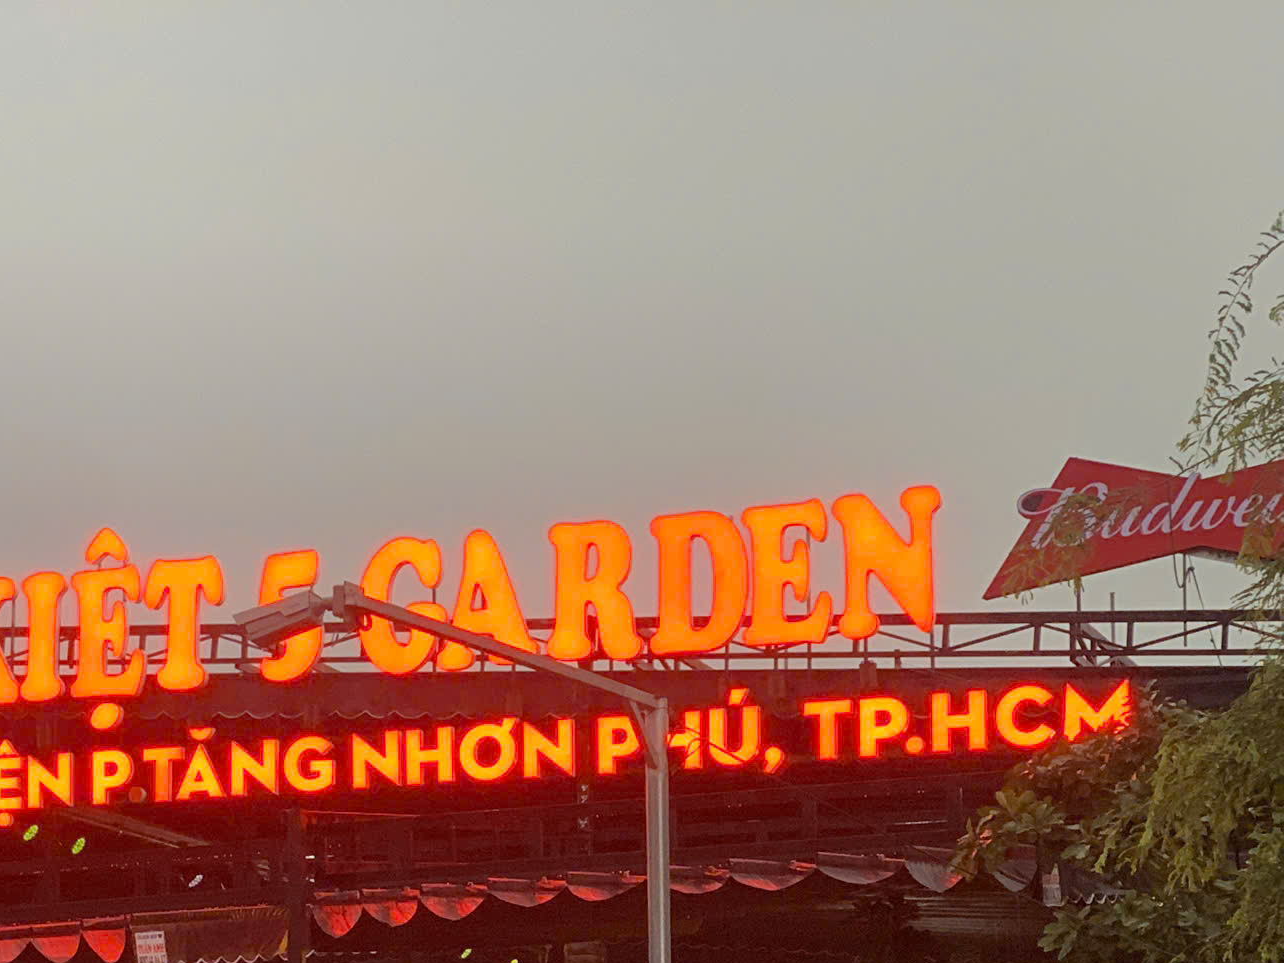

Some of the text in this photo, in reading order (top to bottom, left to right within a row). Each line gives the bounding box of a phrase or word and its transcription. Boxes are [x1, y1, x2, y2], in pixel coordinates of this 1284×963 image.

[1016, 471, 1284, 549] Budwei
[259, 549, 324, 682] 5
[360, 484, 942, 675] GARDEN
[351, 717, 575, 788] NHƠN
[597, 688, 785, 775] PHÚ,
[802, 678, 1134, 758] TP.HCM
